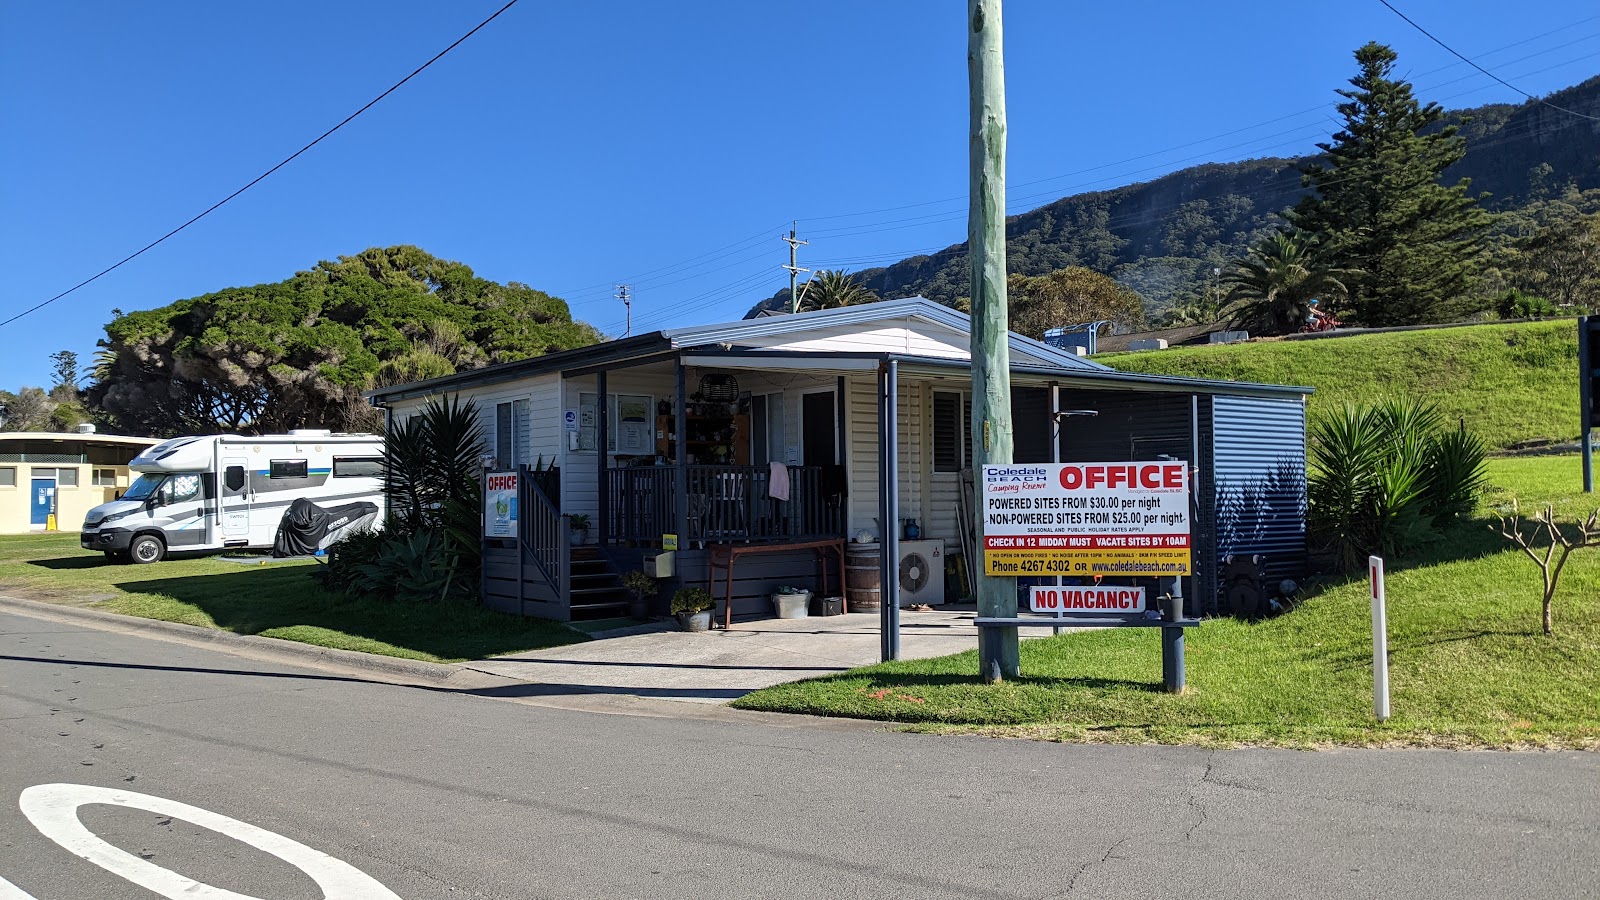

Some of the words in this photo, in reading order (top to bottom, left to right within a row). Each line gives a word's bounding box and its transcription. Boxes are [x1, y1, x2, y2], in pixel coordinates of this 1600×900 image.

[987, 467, 1047, 476] Coledale
[1059, 465, 1183, 490] OFFICE
[488, 475, 517, 491] OFFICE
[988, 483, 1019, 494] Camping
[1022, 481, 1047, 490] Reserve
[989, 498, 1032, 510] POWERED
[1034, 497, 1060, 509] SITES
[1062, 497, 1087, 509] FROM
[1090, 496, 1119, 510] $30.00
[1121, 499, 1136, 511] per
[1138, 496, 1160, 511] night
[989, 513, 1054, 525] NON-POWERED
[1056, 512, 1082, 524] SITES
[1084, 512, 1110, 524] FROM
[1112, 512, 1141, 525] $25.00
[1144, 514, 1158, 526] per
[1160, 511, 1183, 526] night
[988, 538, 1015, 547] CHECK
[1016, 538, 1025, 547] IN
[1027, 537, 1036, 547] 12
[1038, 537, 1068, 547] MIDDAY
[1069, 537, 1091, 547] MUST
[1096, 537, 1126, 546] VACATE
[1128, 536, 1151, 546] SITES
[1152, 536, 1164, 546] BY
[1165, 536, 1187, 546] 10AM
[992, 560, 1018, 571] Phone
[1020, 560, 1045, 572] 4267
[1046, 560, 1070, 572] 4302
[1074, 562, 1087, 571] OR
[1091, 560, 1187, 572] www.coledalebeach.com.au
[1035, 590, 1058, 609] NO
[1061, 590, 1141, 609] VACANCY
